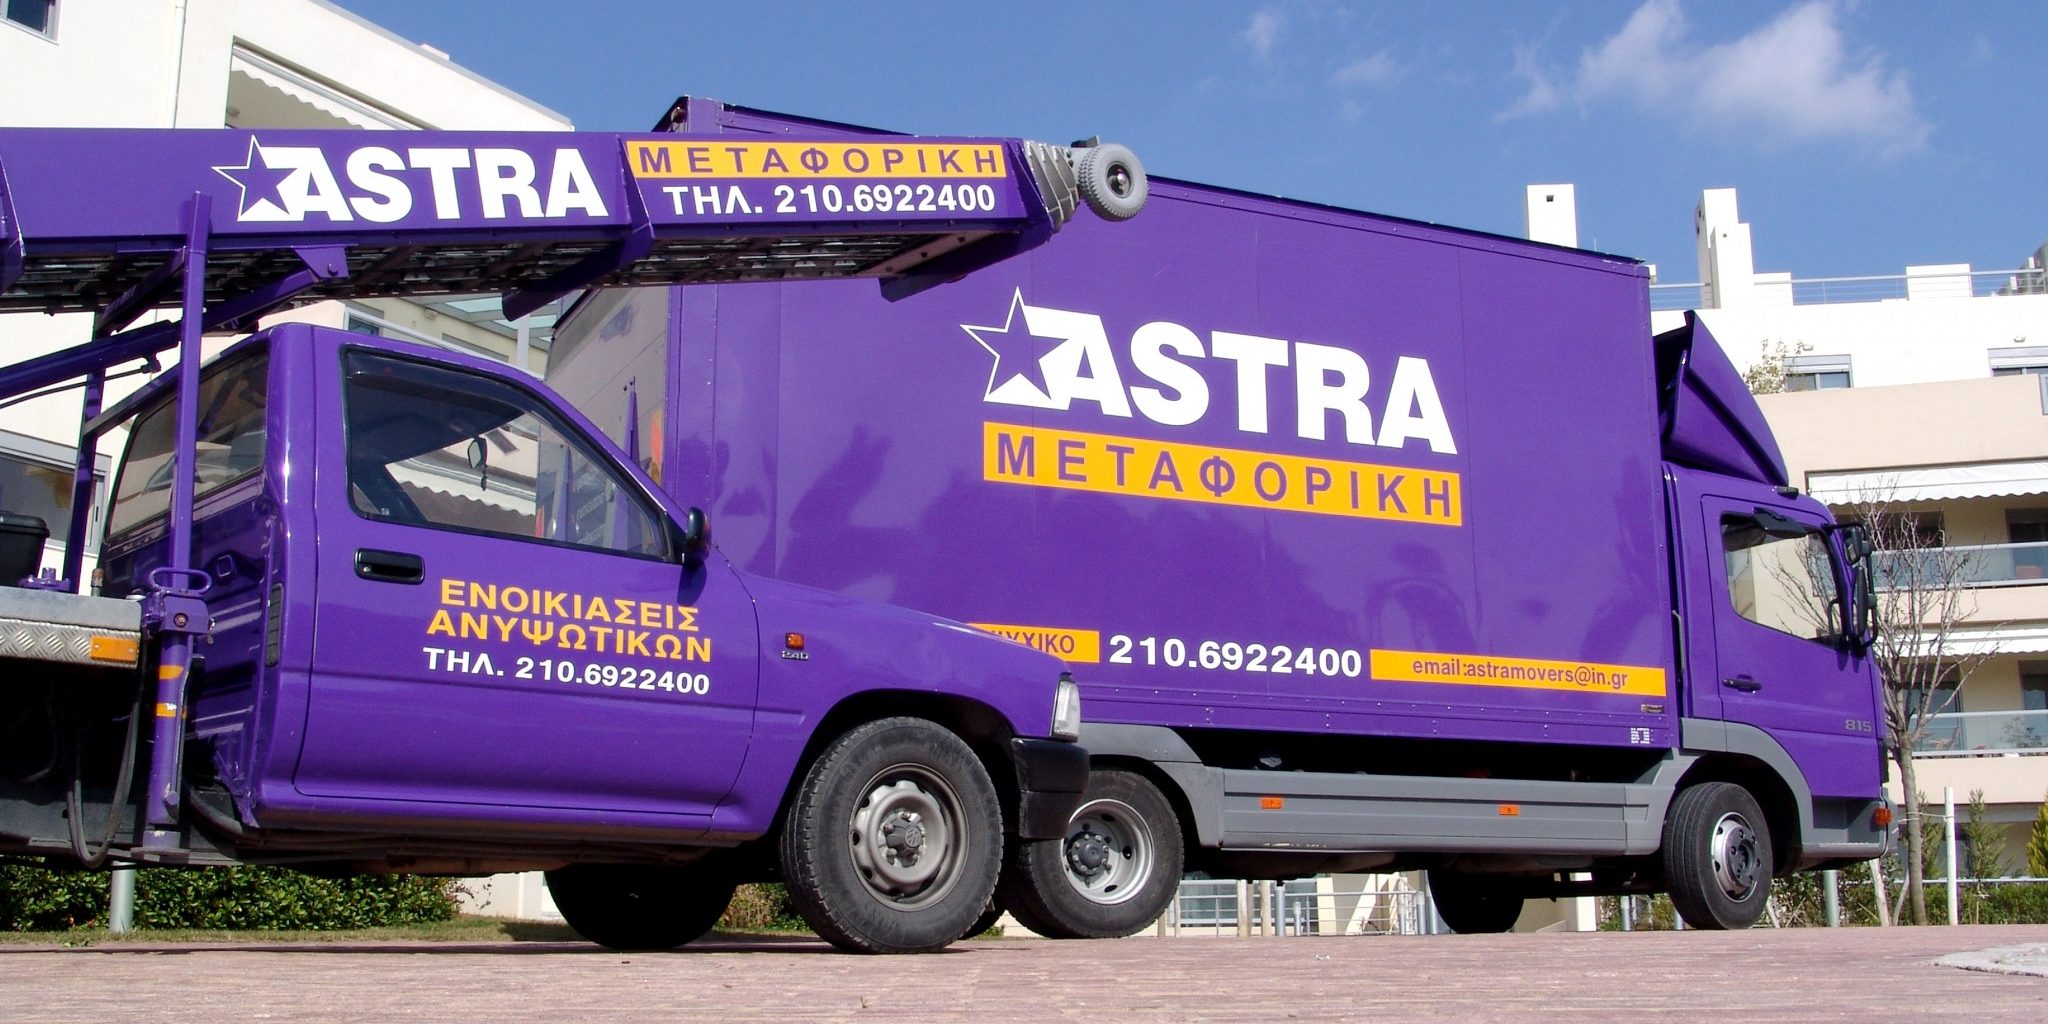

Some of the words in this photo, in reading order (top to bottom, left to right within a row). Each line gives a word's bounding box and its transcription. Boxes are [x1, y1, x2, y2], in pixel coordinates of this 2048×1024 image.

[258, 146, 608, 220] ASTRA
[637, 145, 1003, 175] ΜΕΤΑΦΟΡΙΚΗ
[662, 185, 763, 216] ΤΗΛ.
[775, 184, 996, 215] 210.6922400
[1018, 304, 1457, 455] ASTRA
[996, 432, 1453, 518] ΜΕΤΑΦΟΡΙΚΗ
[441, 579, 701, 632] ΕΝΟΙΚΙΑΣΕΙΣ
[427, 610, 711, 664] ΑΝΥΨΩΤΙΚΩΝ
[1109, 634, 1362, 678] 210.6922400
[422, 647, 504, 678] ΤΗΛ.
[515, 656, 711, 695] 210.6922400
[1844, 718, 1872, 732] 815
